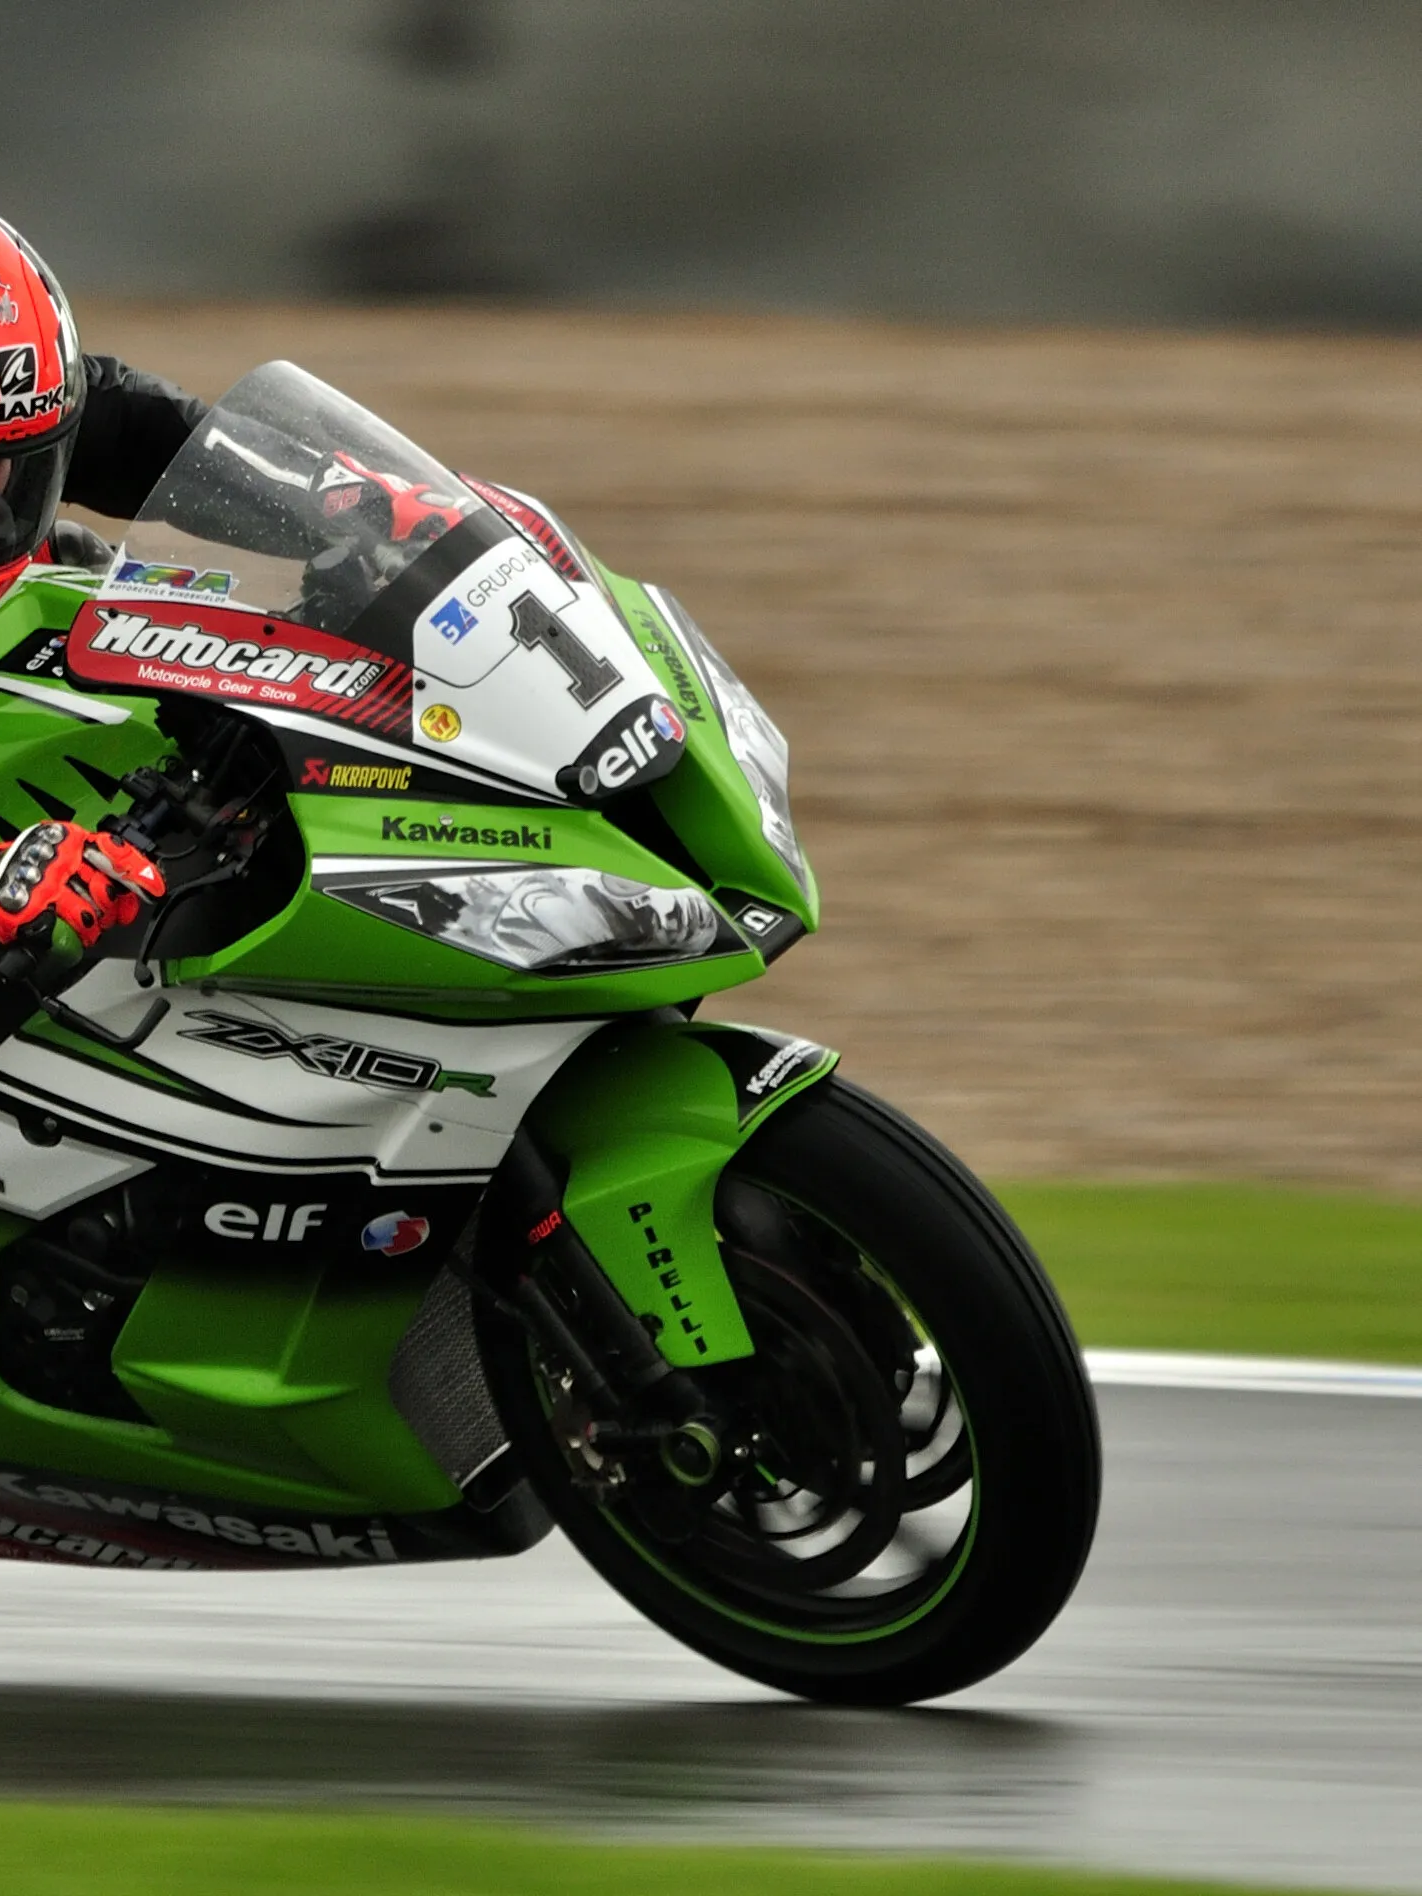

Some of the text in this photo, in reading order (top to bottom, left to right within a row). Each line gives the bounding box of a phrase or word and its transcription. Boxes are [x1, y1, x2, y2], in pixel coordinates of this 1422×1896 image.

[466, 556, 526, 608] GRUPO
[508, 589, 625, 711] 1
[137, 664, 297, 702] Motorcycle Gear Store
[597, 714, 658, 788] elf
[382, 815, 552, 850] Kawasaki
[204, 1202, 327, 1242] elf
[628, 1202, 709, 1356] PIRELLI
